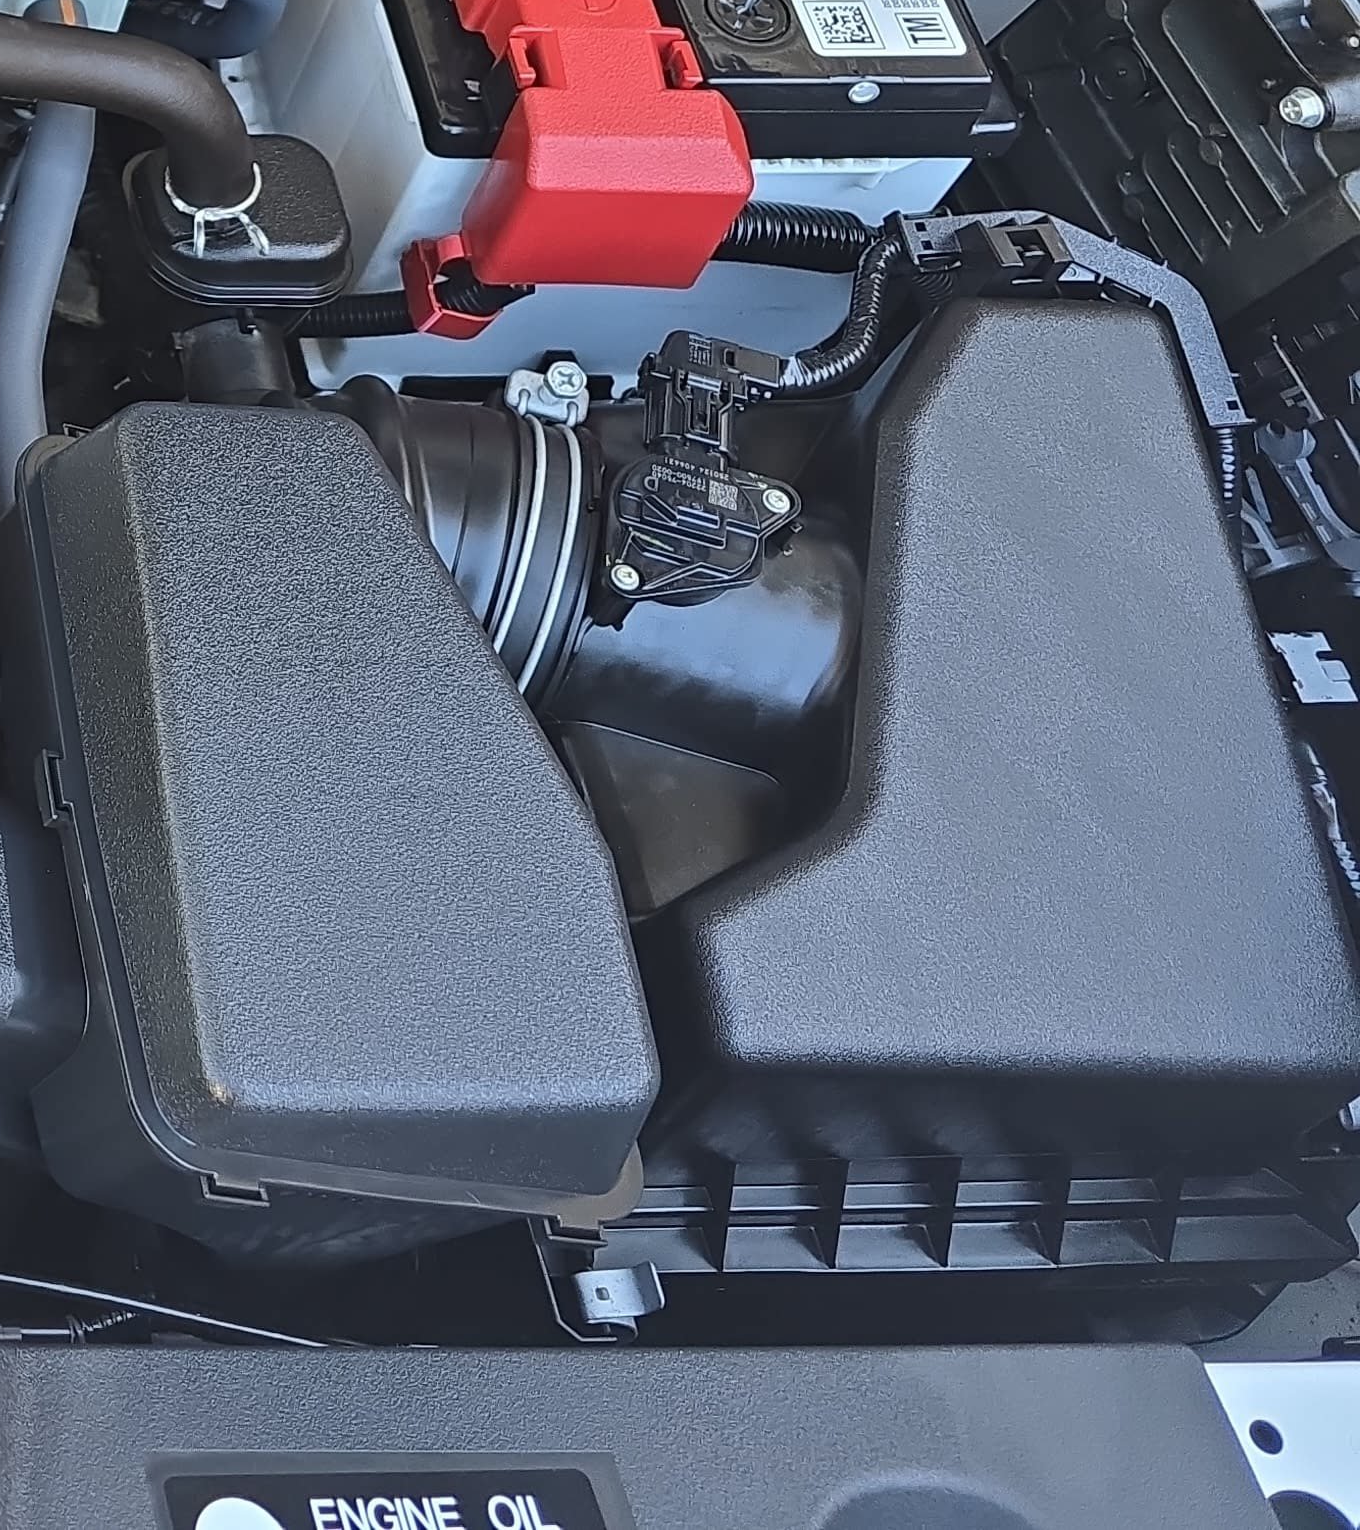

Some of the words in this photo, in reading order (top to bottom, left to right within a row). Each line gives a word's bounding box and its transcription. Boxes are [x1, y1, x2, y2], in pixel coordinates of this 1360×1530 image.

[902, 16, 947, 44] TM
[309, 1496, 467, 1530] ENGINE
[487, 1494, 561, 1530] OIL
